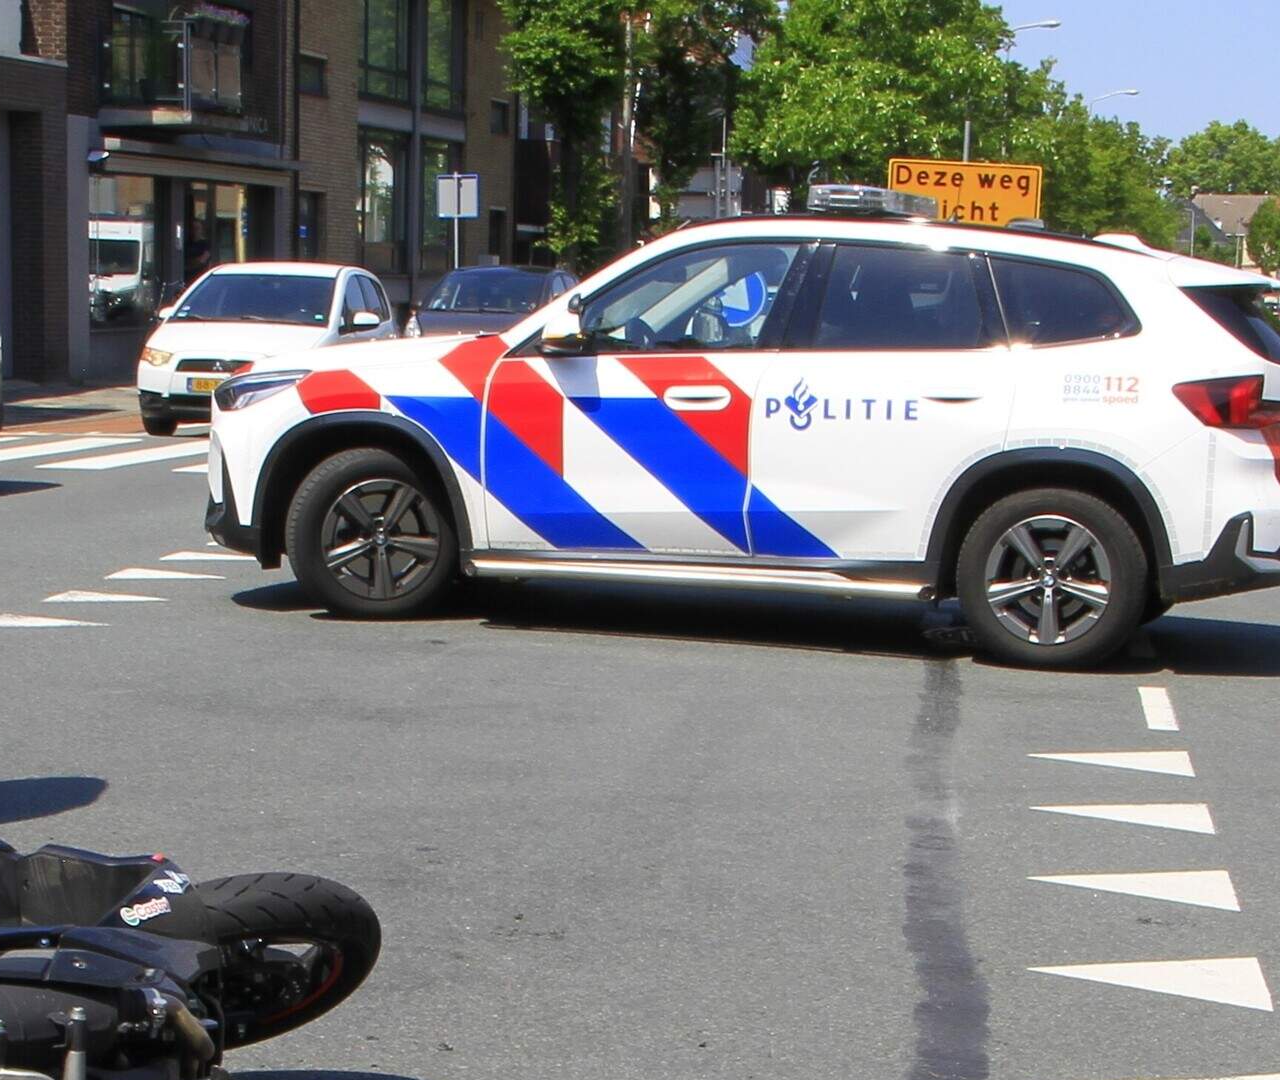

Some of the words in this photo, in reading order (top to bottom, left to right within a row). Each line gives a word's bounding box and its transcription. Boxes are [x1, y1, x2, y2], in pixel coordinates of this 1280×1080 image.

[896, 165, 964, 187] Deze
[978, 173, 1031, 197] weg
[942, 199, 999, 221] icht
[1064, 374, 1101, 384] 0900
[1104, 376, 1140, 393] 112
[1063, 385, 1100, 395] 8844
[1102, 395, 1139, 405] spoed
